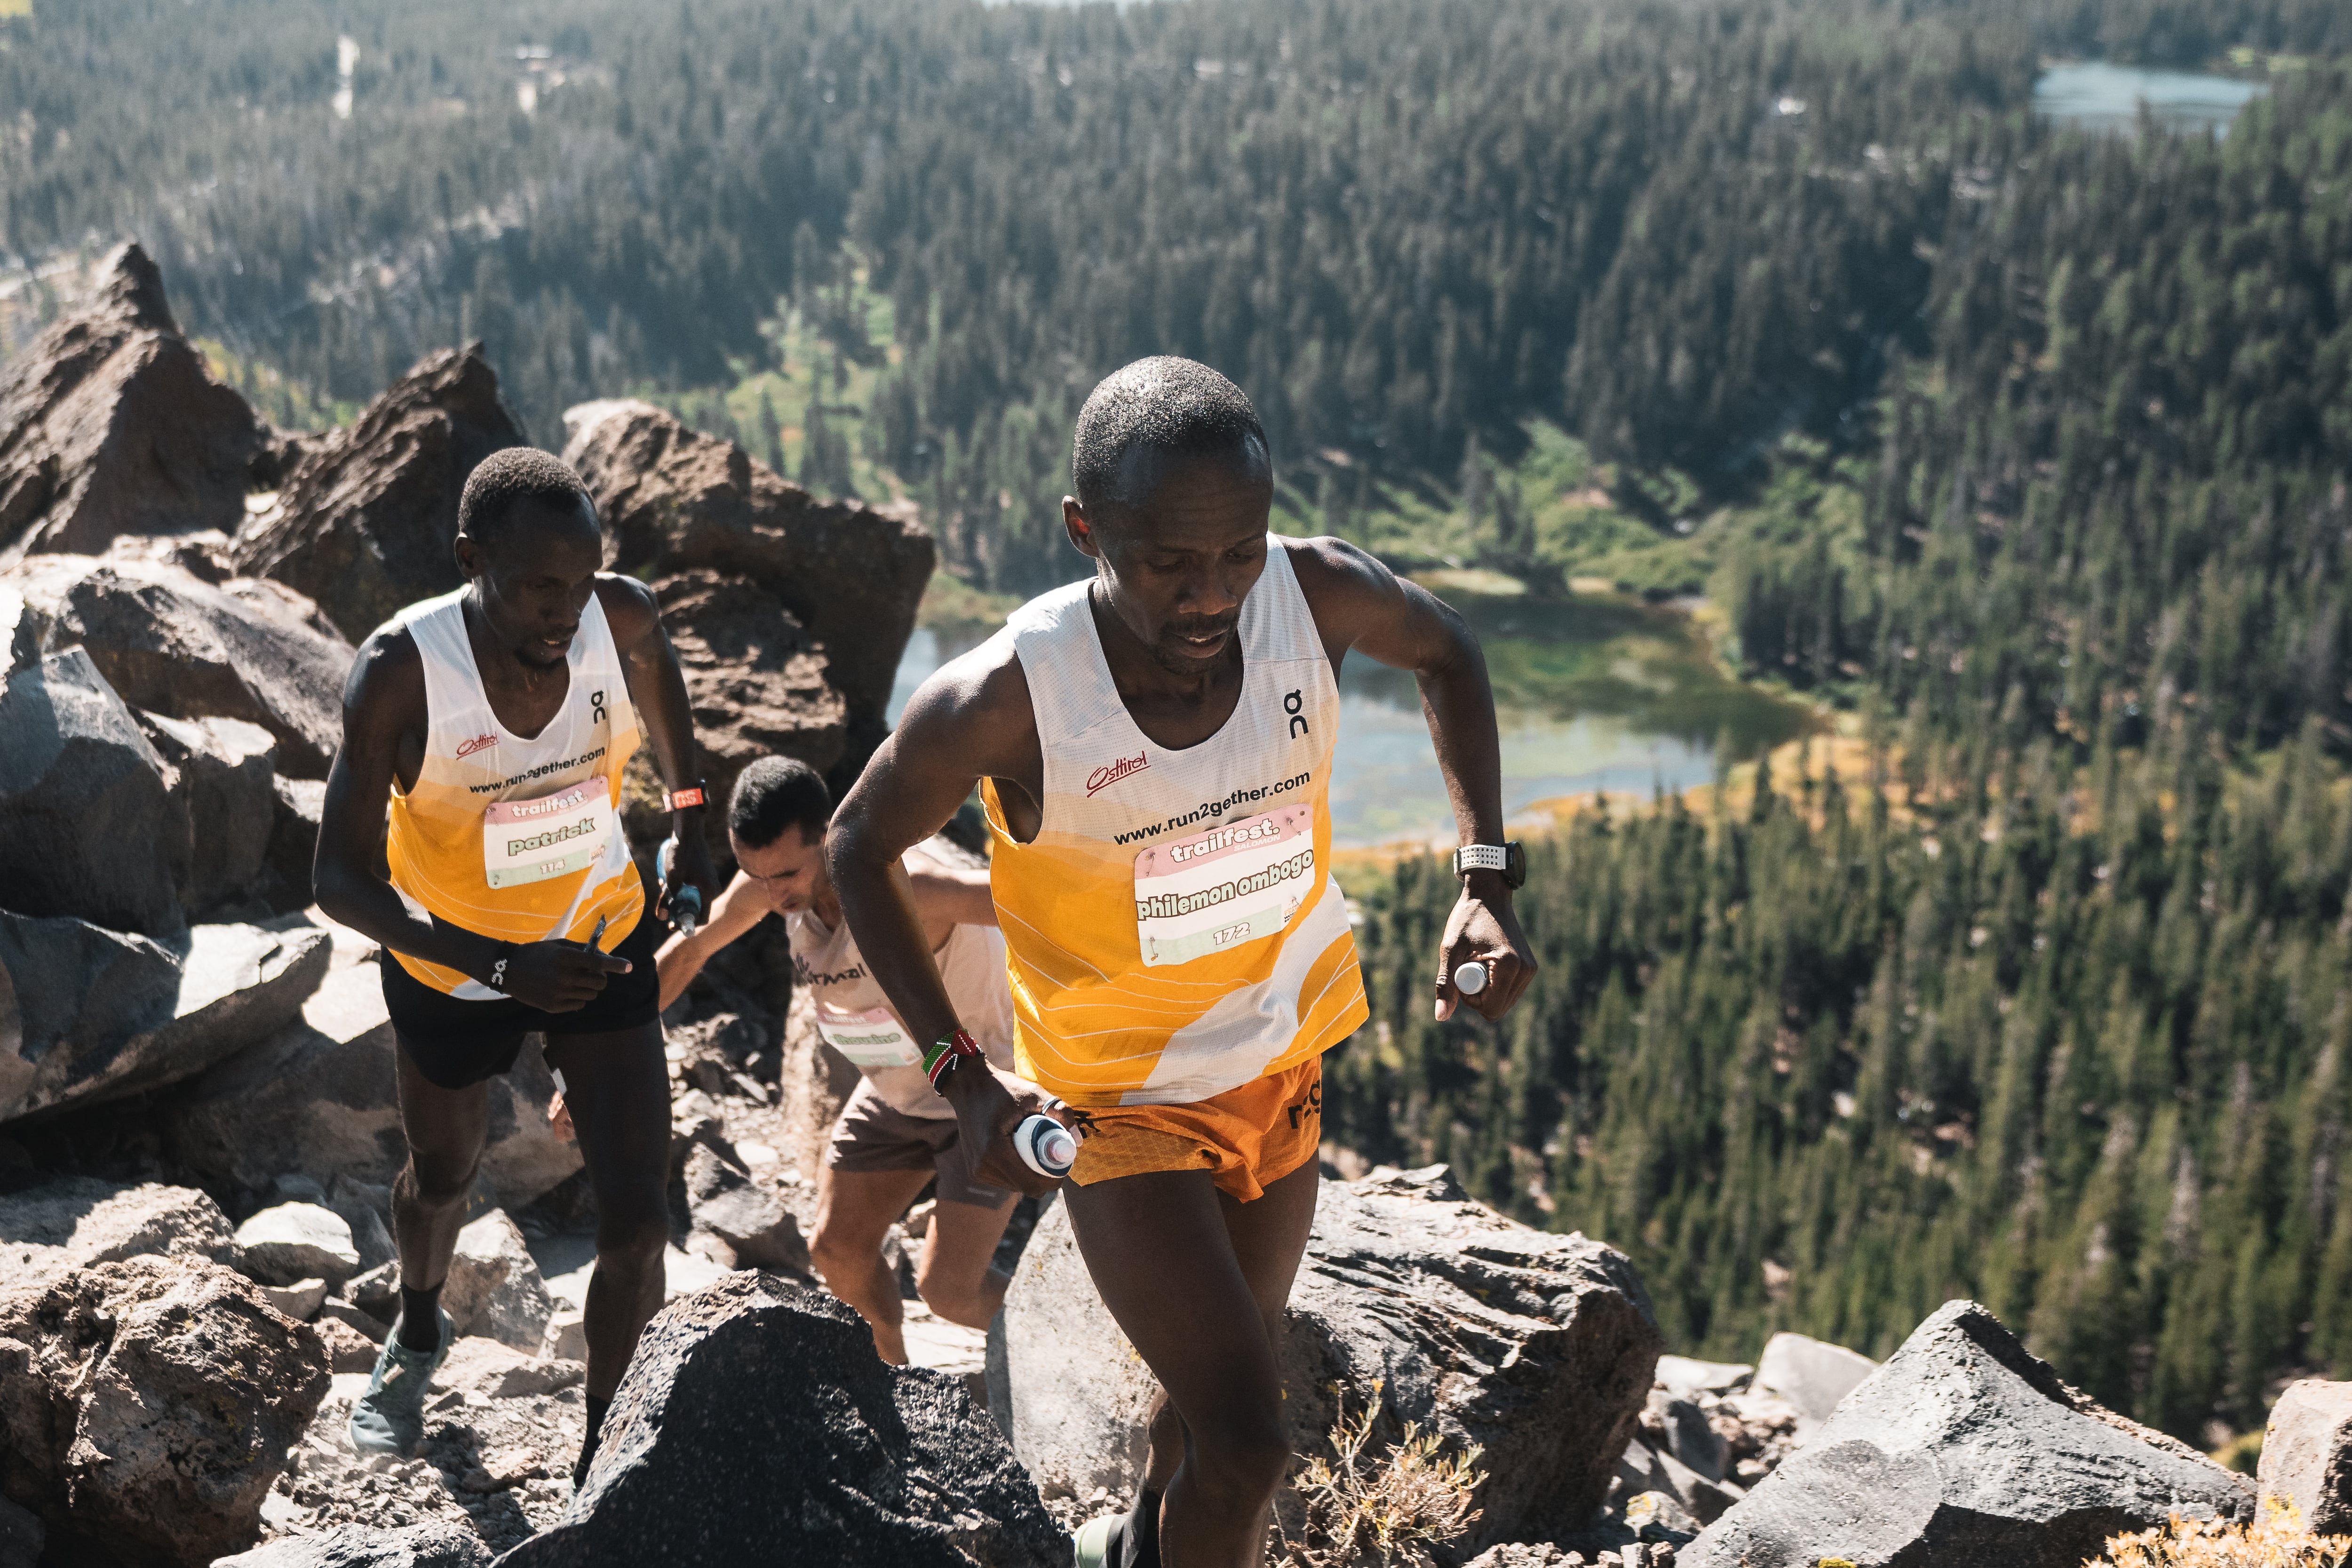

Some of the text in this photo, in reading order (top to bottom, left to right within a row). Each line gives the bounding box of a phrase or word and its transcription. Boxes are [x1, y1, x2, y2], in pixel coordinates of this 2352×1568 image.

[469, 747, 605, 794] www.run2gether.com
[1114, 771, 1311, 846] www.run2gether.com
[508, 817, 596, 857] patrick
[1170, 818, 1280, 863] trailfest.
[1233, 834, 1281, 852] SALOMON
[540, 860, 565, 874] 114
[1135, 881, 1236, 921] philemon
[1237, 849, 1315, 896] ombogo
[1213, 922, 1250, 946] 172
